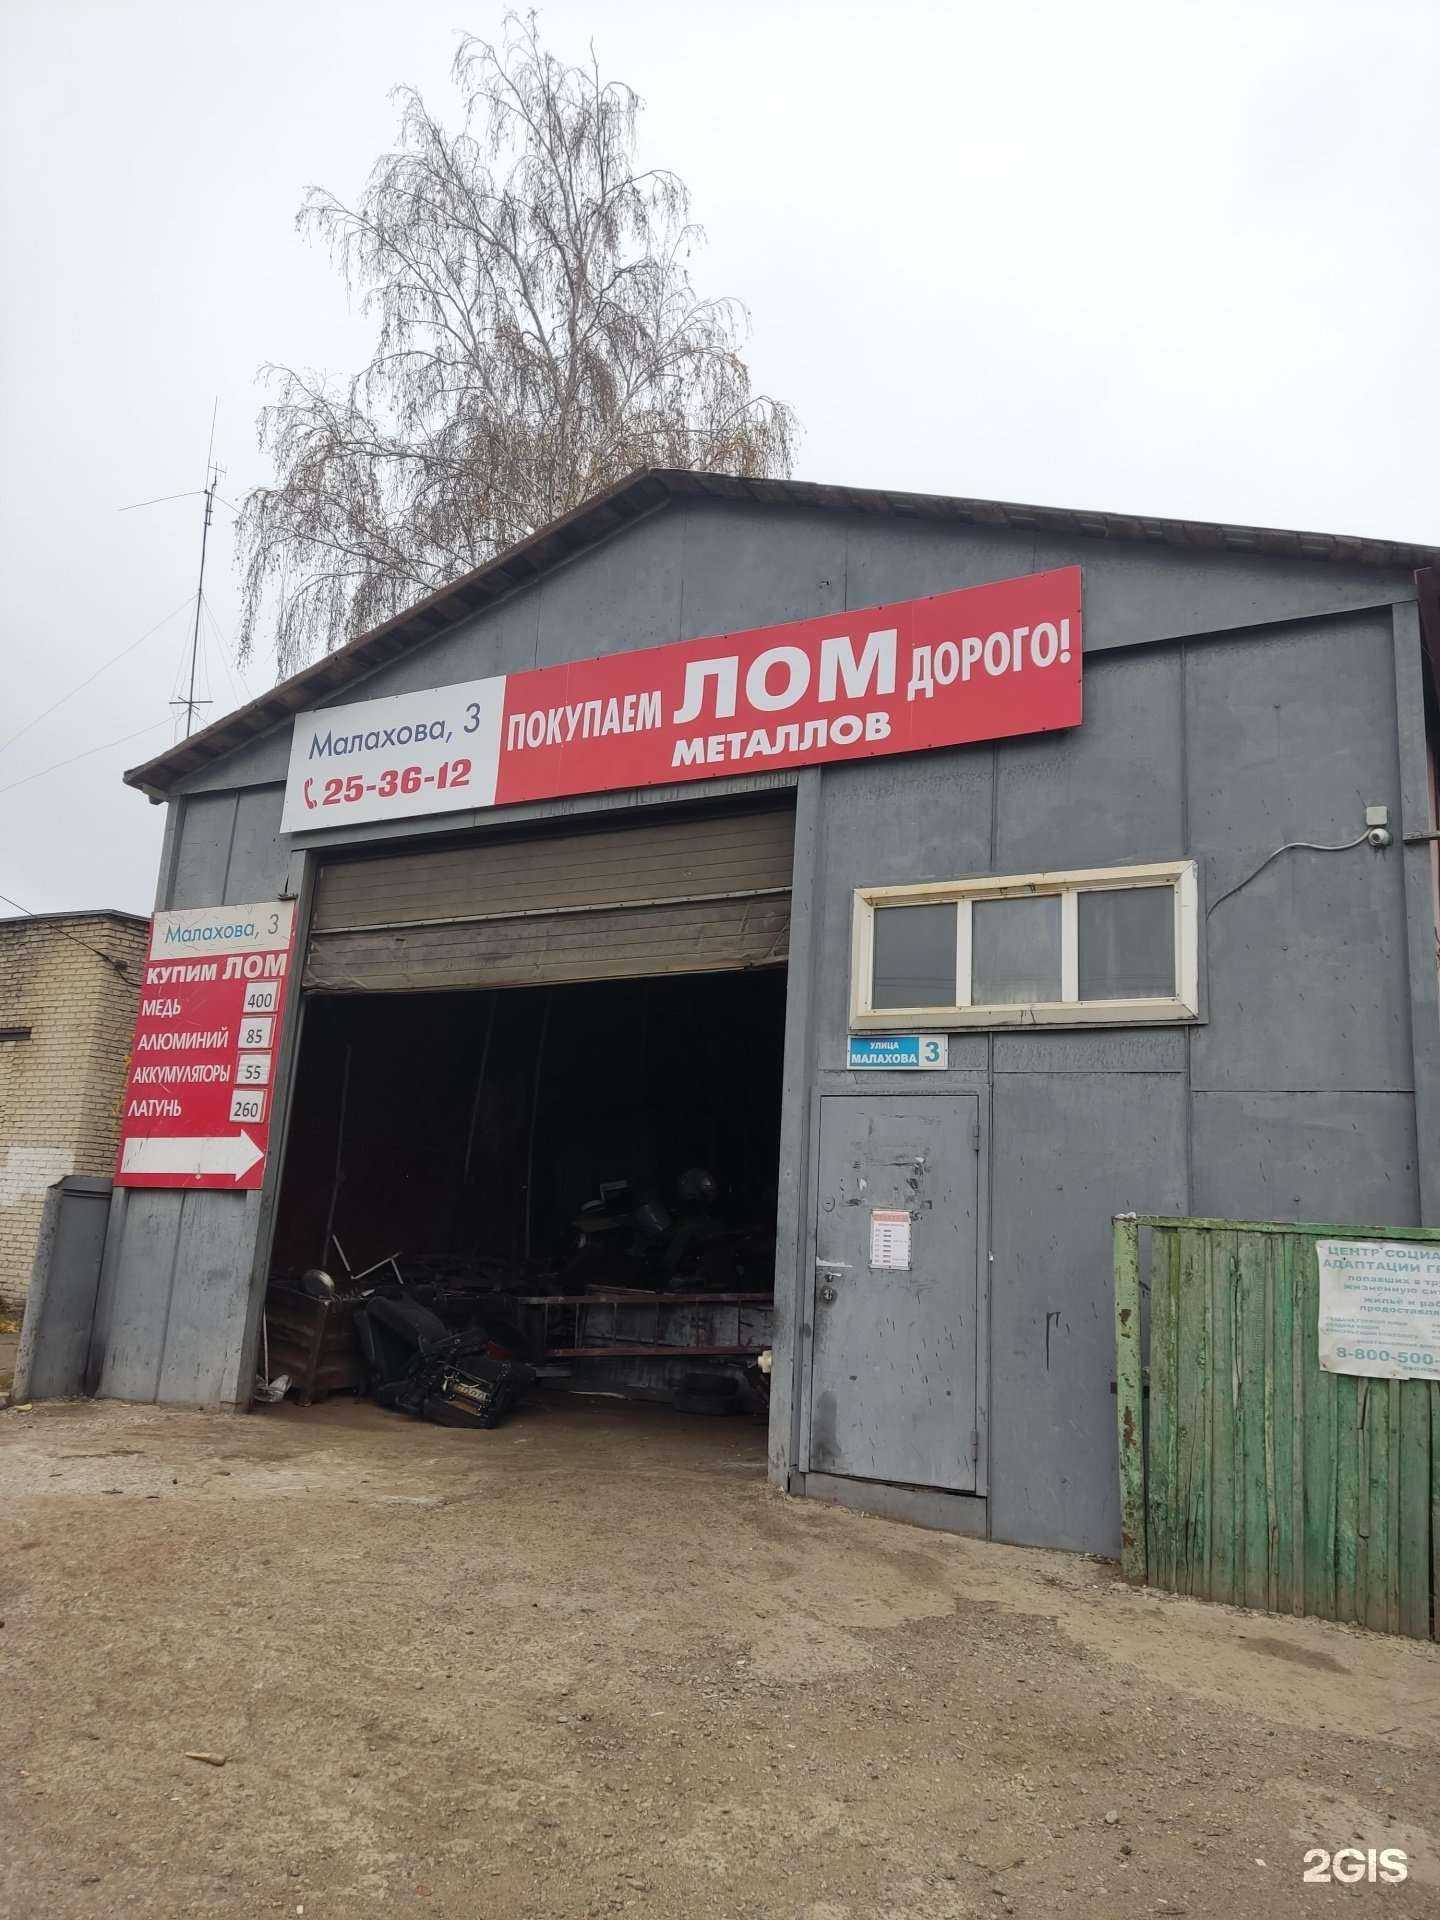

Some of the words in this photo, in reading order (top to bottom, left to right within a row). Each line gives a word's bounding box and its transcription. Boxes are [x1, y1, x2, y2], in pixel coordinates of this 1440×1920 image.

[507, 690, 662, 751] ПОКУПАЕМ
[672, 628, 898, 724] ЛОМ
[907, 618, 1071, 701] ДОРОГО!
[308, 716, 453, 760] Малахова,
[463, 702, 481, 734] 3
[671, 711, 891, 768] МЕТАЛЛОВ
[322, 758, 472, 806] 25-36-12
[165, 923, 259, 945] Малахова,
[267, 913, 280, 935] 3
[146, 963, 218, 985] КУПИМ
[222, 953, 288, 980] ЛОМ
[142, 999, 182, 1018] МЕДЬ
[247, 993, 272, 1009] 400
[137, 1026, 230, 1050] АЛЮМИНИЙ
[246, 1029, 263, 1044] 85
[870, 1041, 899, 1050] УЛИЦА
[851, 1053, 917, 1064] МАЛАХОВА
[924, 1041, 940, 1063] 3
[132, 1064, 231, 1084] АККУМУЛЯТОРЫ
[244, 1065, 262, 1080] 55
[128, 1099, 182, 1117] ЛАТУНЬ
[233, 1102, 259, 1118] 260
[1328, 1247, 1380, 1257] ЦЕНТР
[1323, 1259, 1421, 1273] АДАПТАЦИИ
